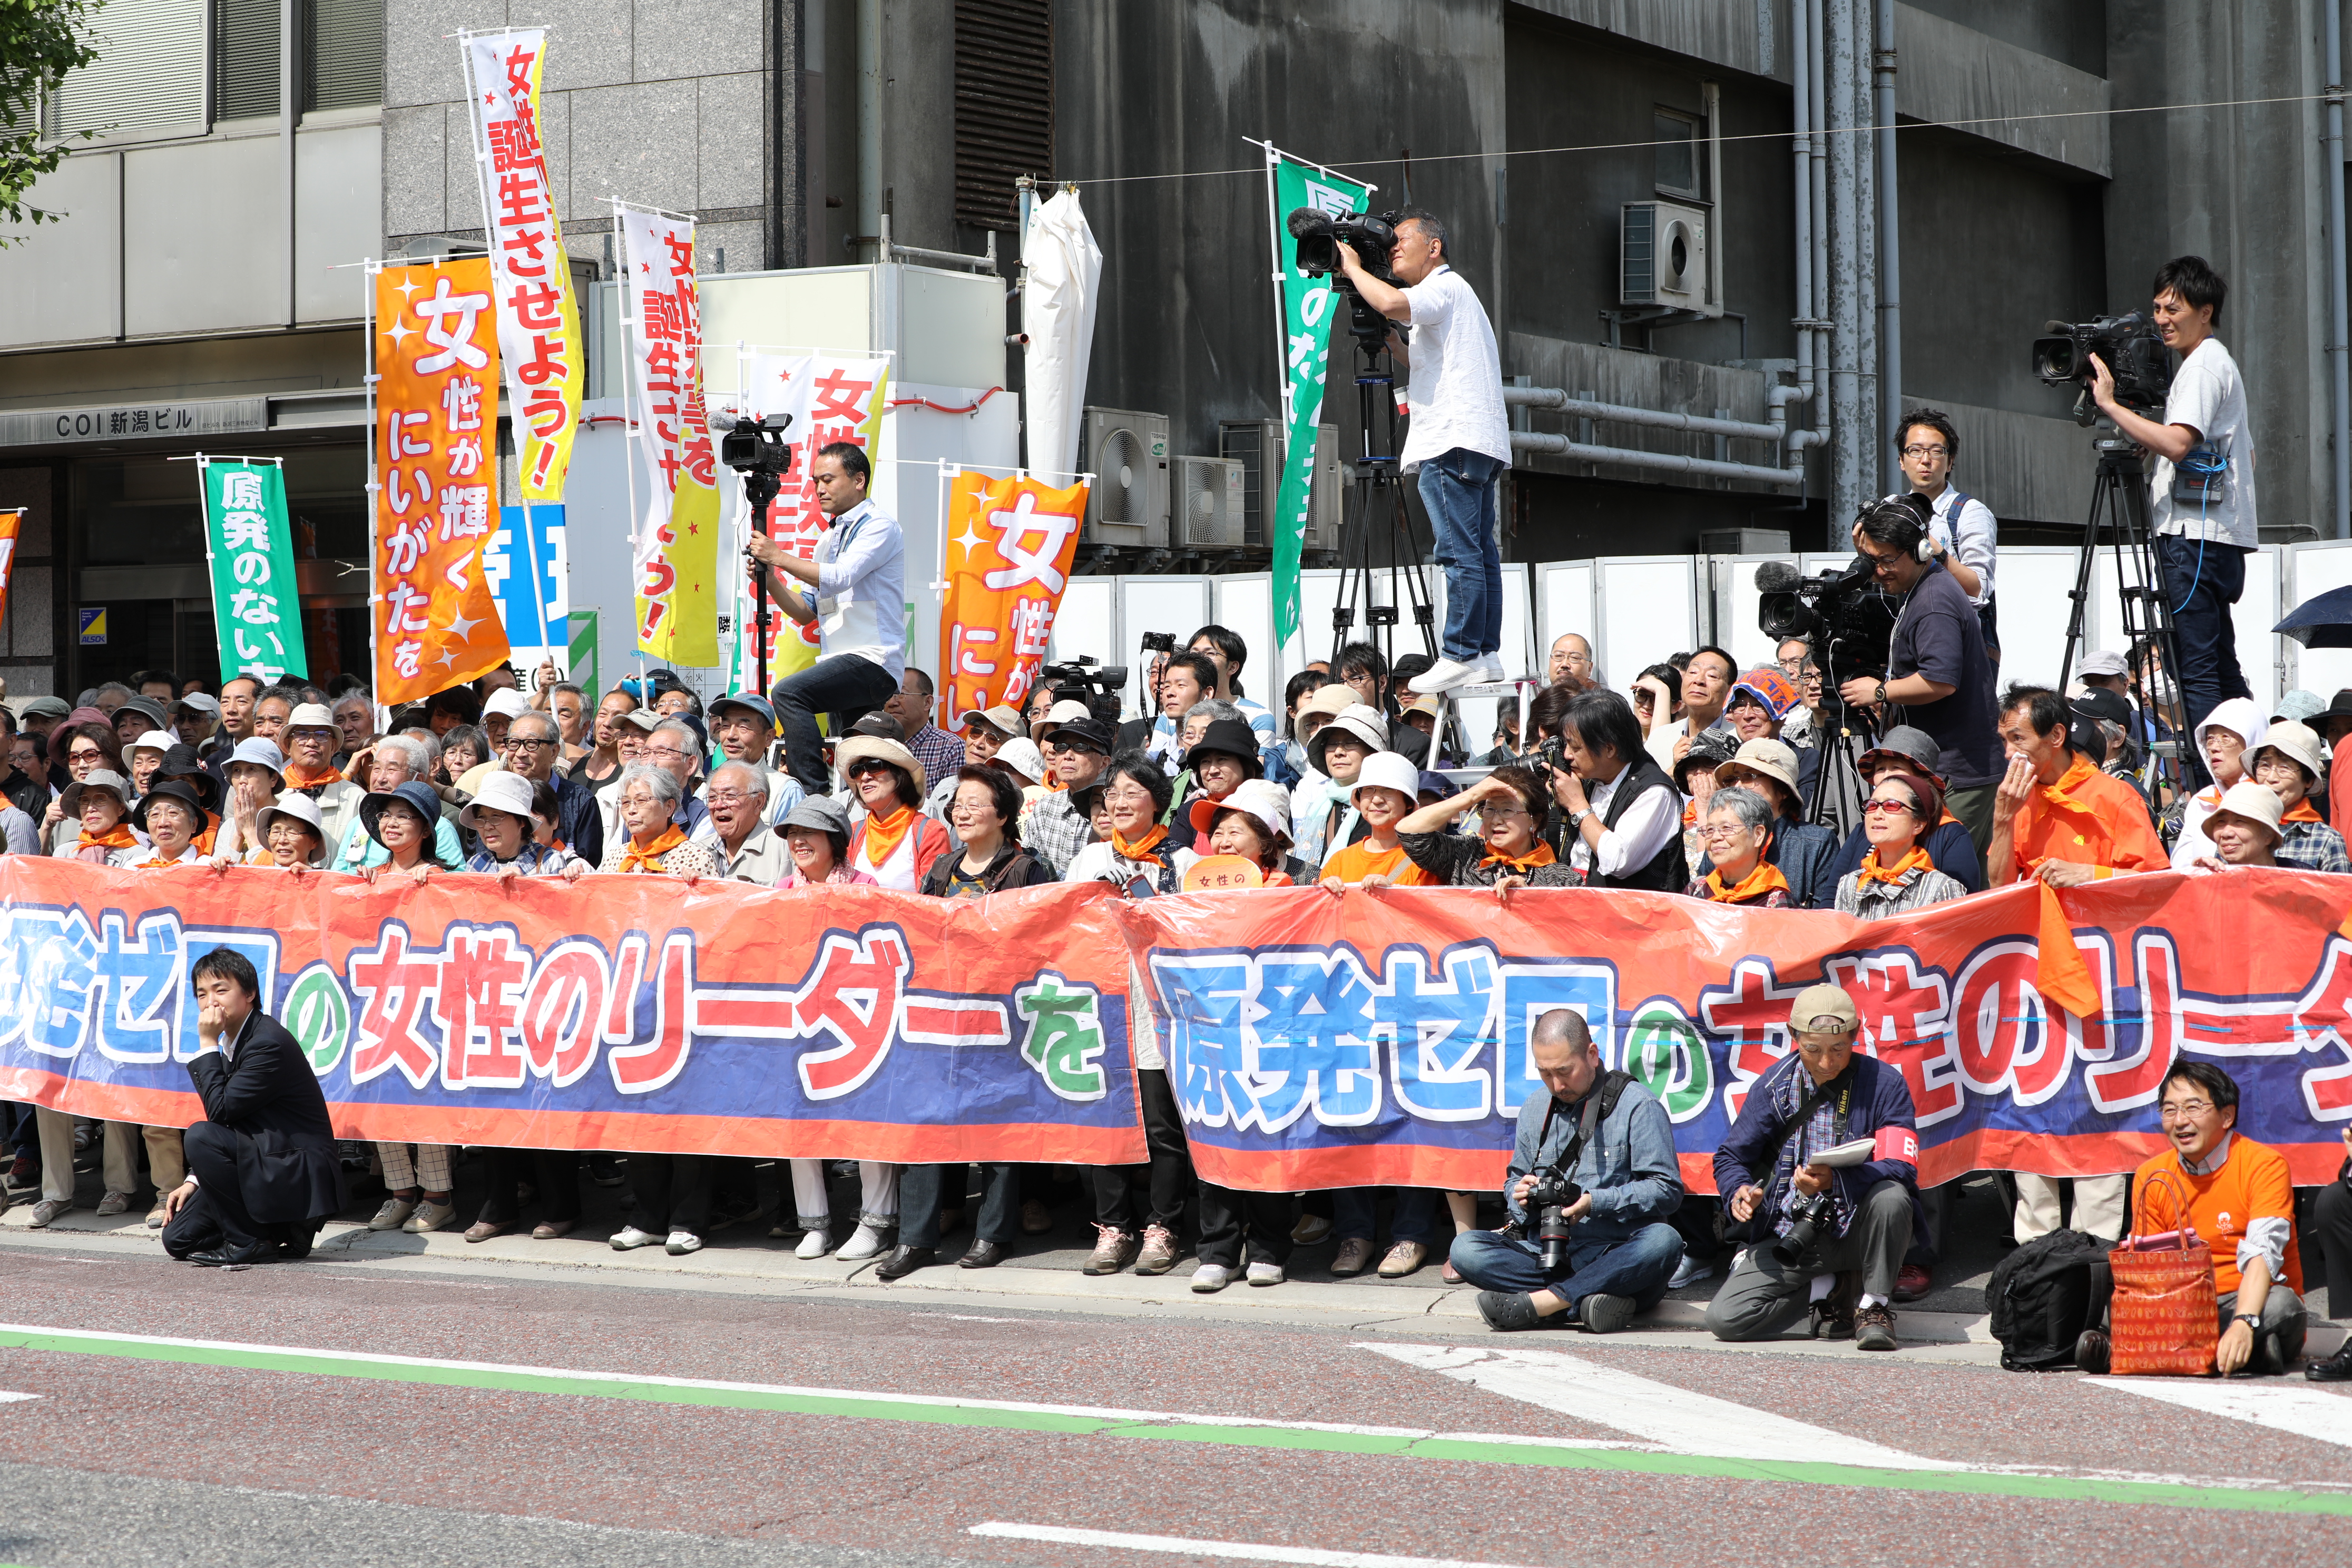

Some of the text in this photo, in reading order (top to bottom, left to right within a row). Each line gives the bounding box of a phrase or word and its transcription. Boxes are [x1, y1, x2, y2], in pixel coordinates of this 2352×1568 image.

[57, 407, 192, 437] COI 新潟ビル
[412, 276, 491, 593] 女性が輝く
[385, 409, 432, 681] にいがたを
[695, 673, 703, 682] 火
[695, 689, 703, 697] 水
[1199, 874, 1245, 887] 女性の
[1838, 1090, 1848, 1114] Nikon
